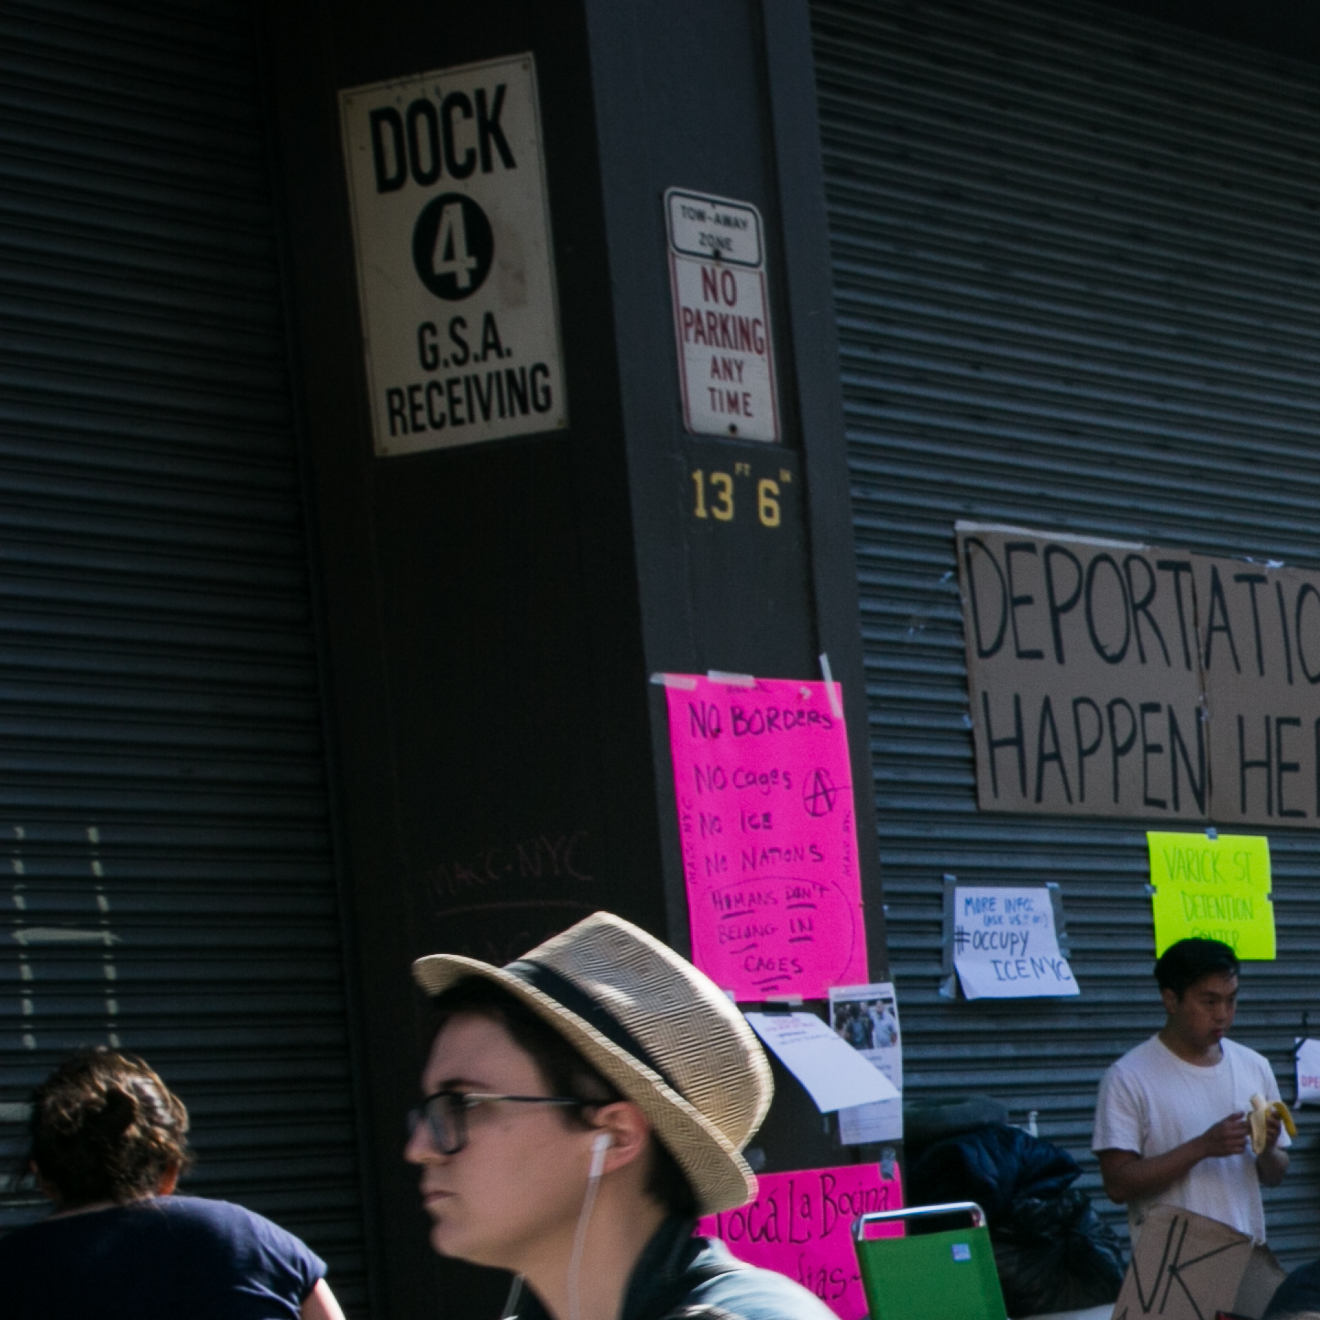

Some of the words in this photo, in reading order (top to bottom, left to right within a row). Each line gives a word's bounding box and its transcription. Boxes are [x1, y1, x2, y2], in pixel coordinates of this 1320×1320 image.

[370, 84, 518, 194] DOCK
[680, 204, 749, 230] TOW-AWAY
[432, 202, 478, 291] 4
[698, 233, 734, 251] ZONE
[702, 266, 738, 307] NO
[417, 311, 512, 372] G.S.A.
[682, 306, 766, 356] PARKING
[710, 355, 745, 384] ANY
[386, 362, 553, 437] RECEIVING
[707, 387, 754, 418] TIME
[692, 469, 735, 522] 13
[757, 478, 781, 528] 6
[688, 700, 722, 738] NO
[730, 704, 833, 738] BORDERS
[980, 691, 1208, 815] HAPPEN
[740, 808, 773, 833] ICE
[1162, 844, 1227, 886] VARICK
[1180, 889, 1255, 923] DETENTION
[954, 925, 1030, 957] #OCCUPY
[743, 955, 804, 974] CAGES
